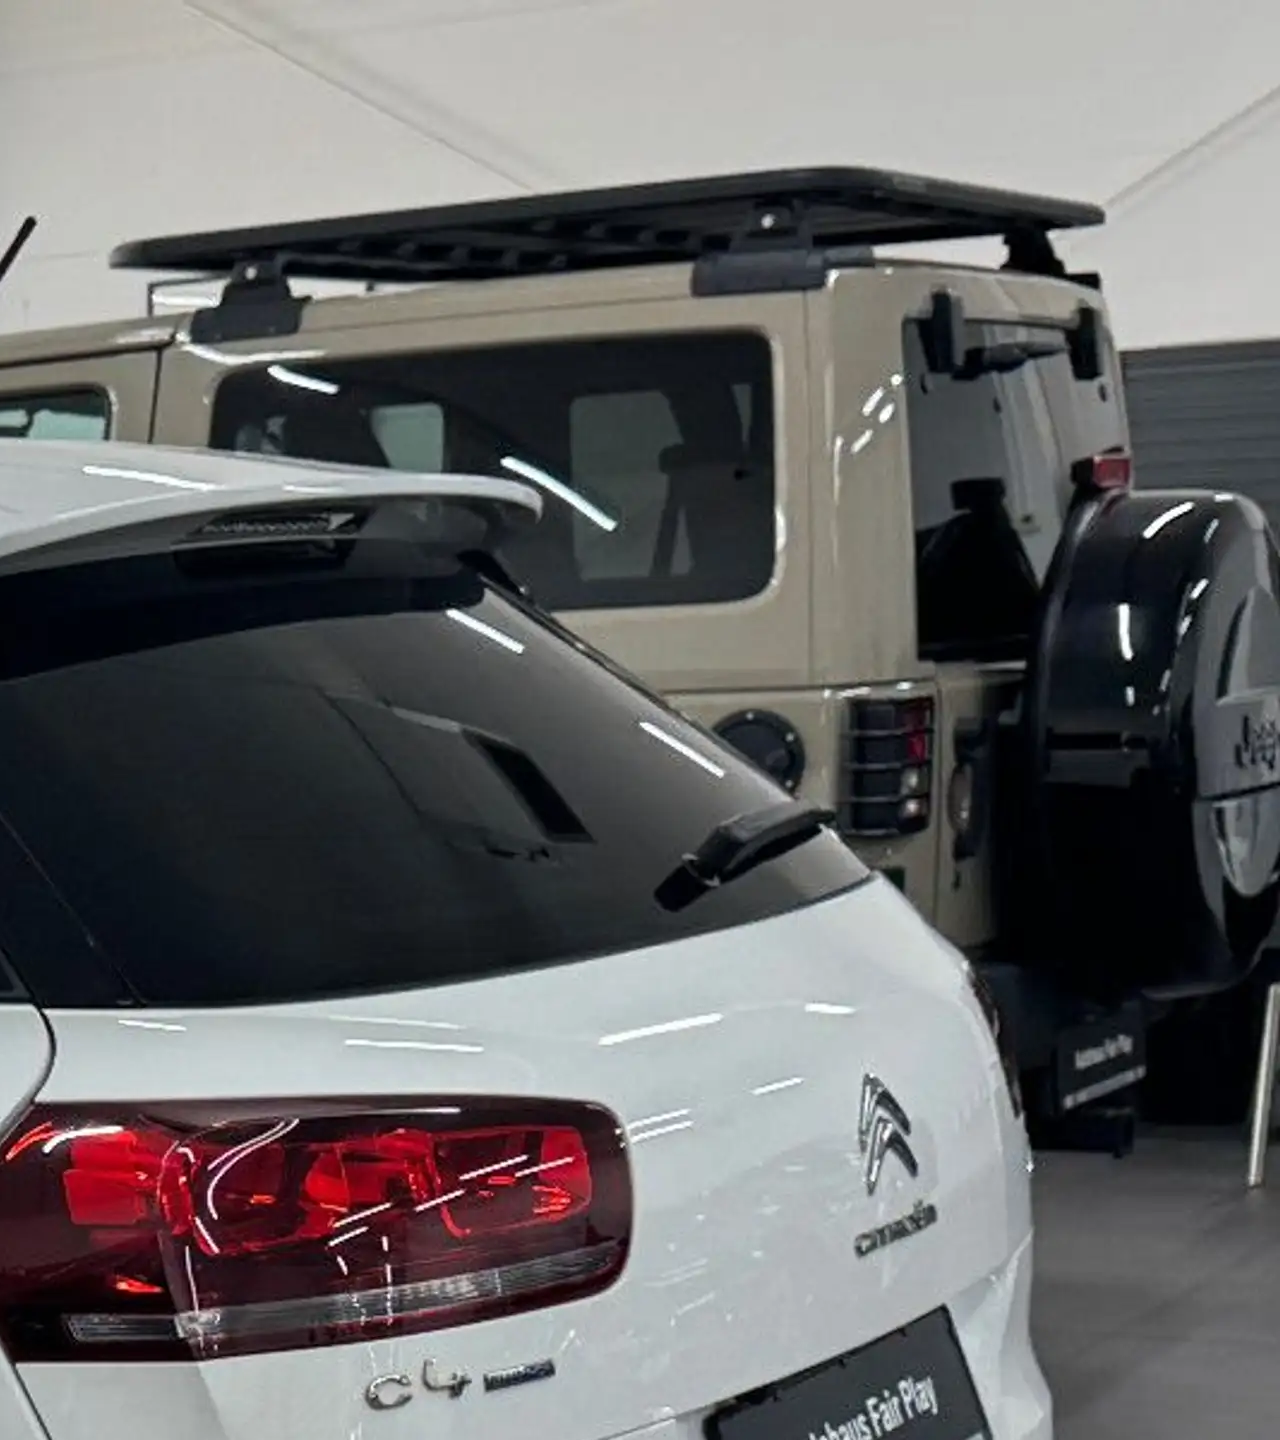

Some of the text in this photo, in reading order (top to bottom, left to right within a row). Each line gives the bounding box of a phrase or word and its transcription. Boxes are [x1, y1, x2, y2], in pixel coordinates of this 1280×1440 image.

[364, 1358, 472, 1411] C4
[865, 1389, 905, 1438] Fair
[897, 1375, 938, 1419] Play
